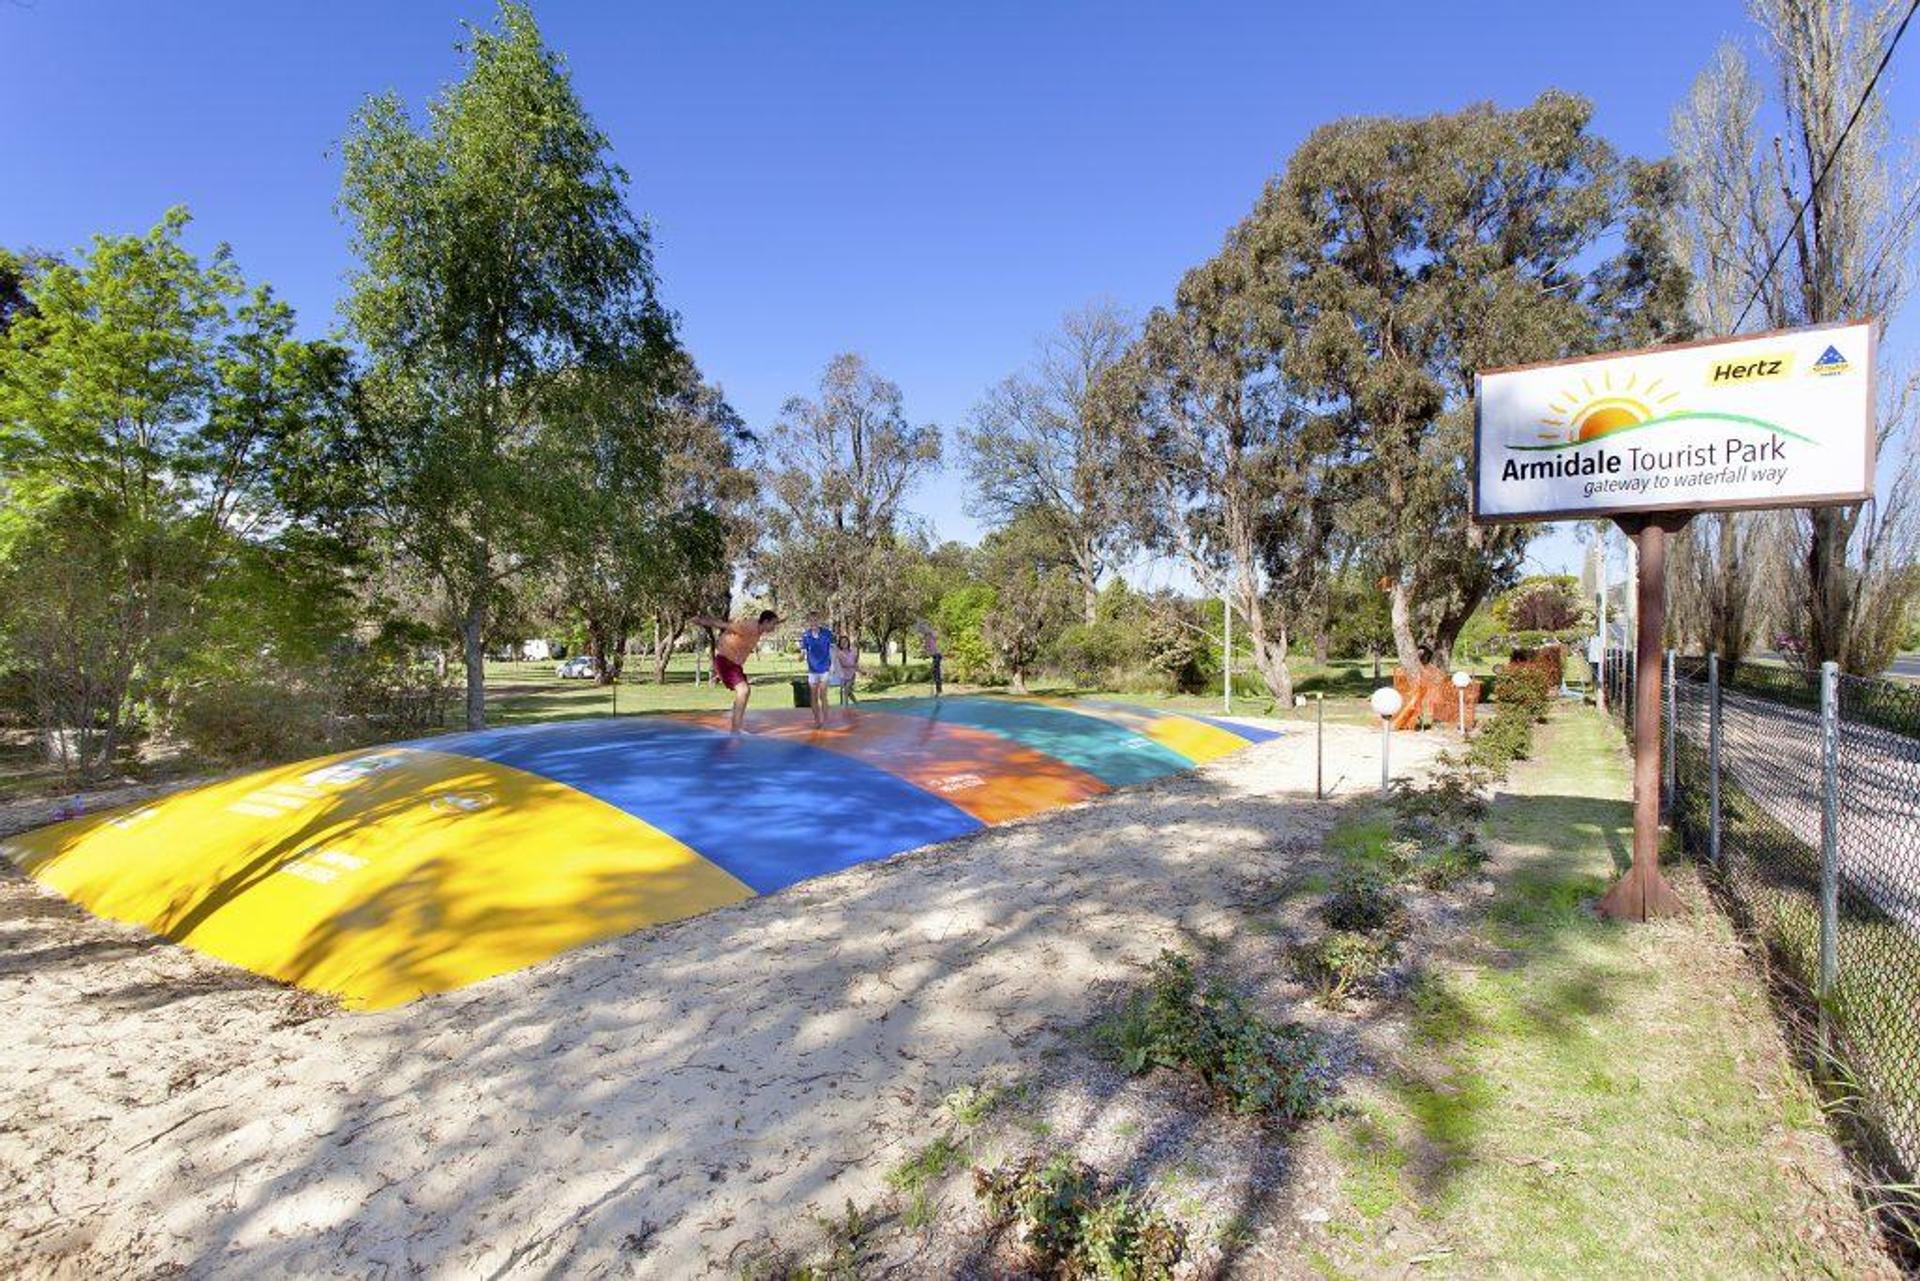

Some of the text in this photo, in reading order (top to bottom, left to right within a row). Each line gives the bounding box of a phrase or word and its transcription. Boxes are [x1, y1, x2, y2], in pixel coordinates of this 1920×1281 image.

[1713, 356, 1783, 382] Hertz
[1502, 433, 1786, 481] Armidale Tourist Park
[1583, 466, 1789, 498] gateway to waterfall way
